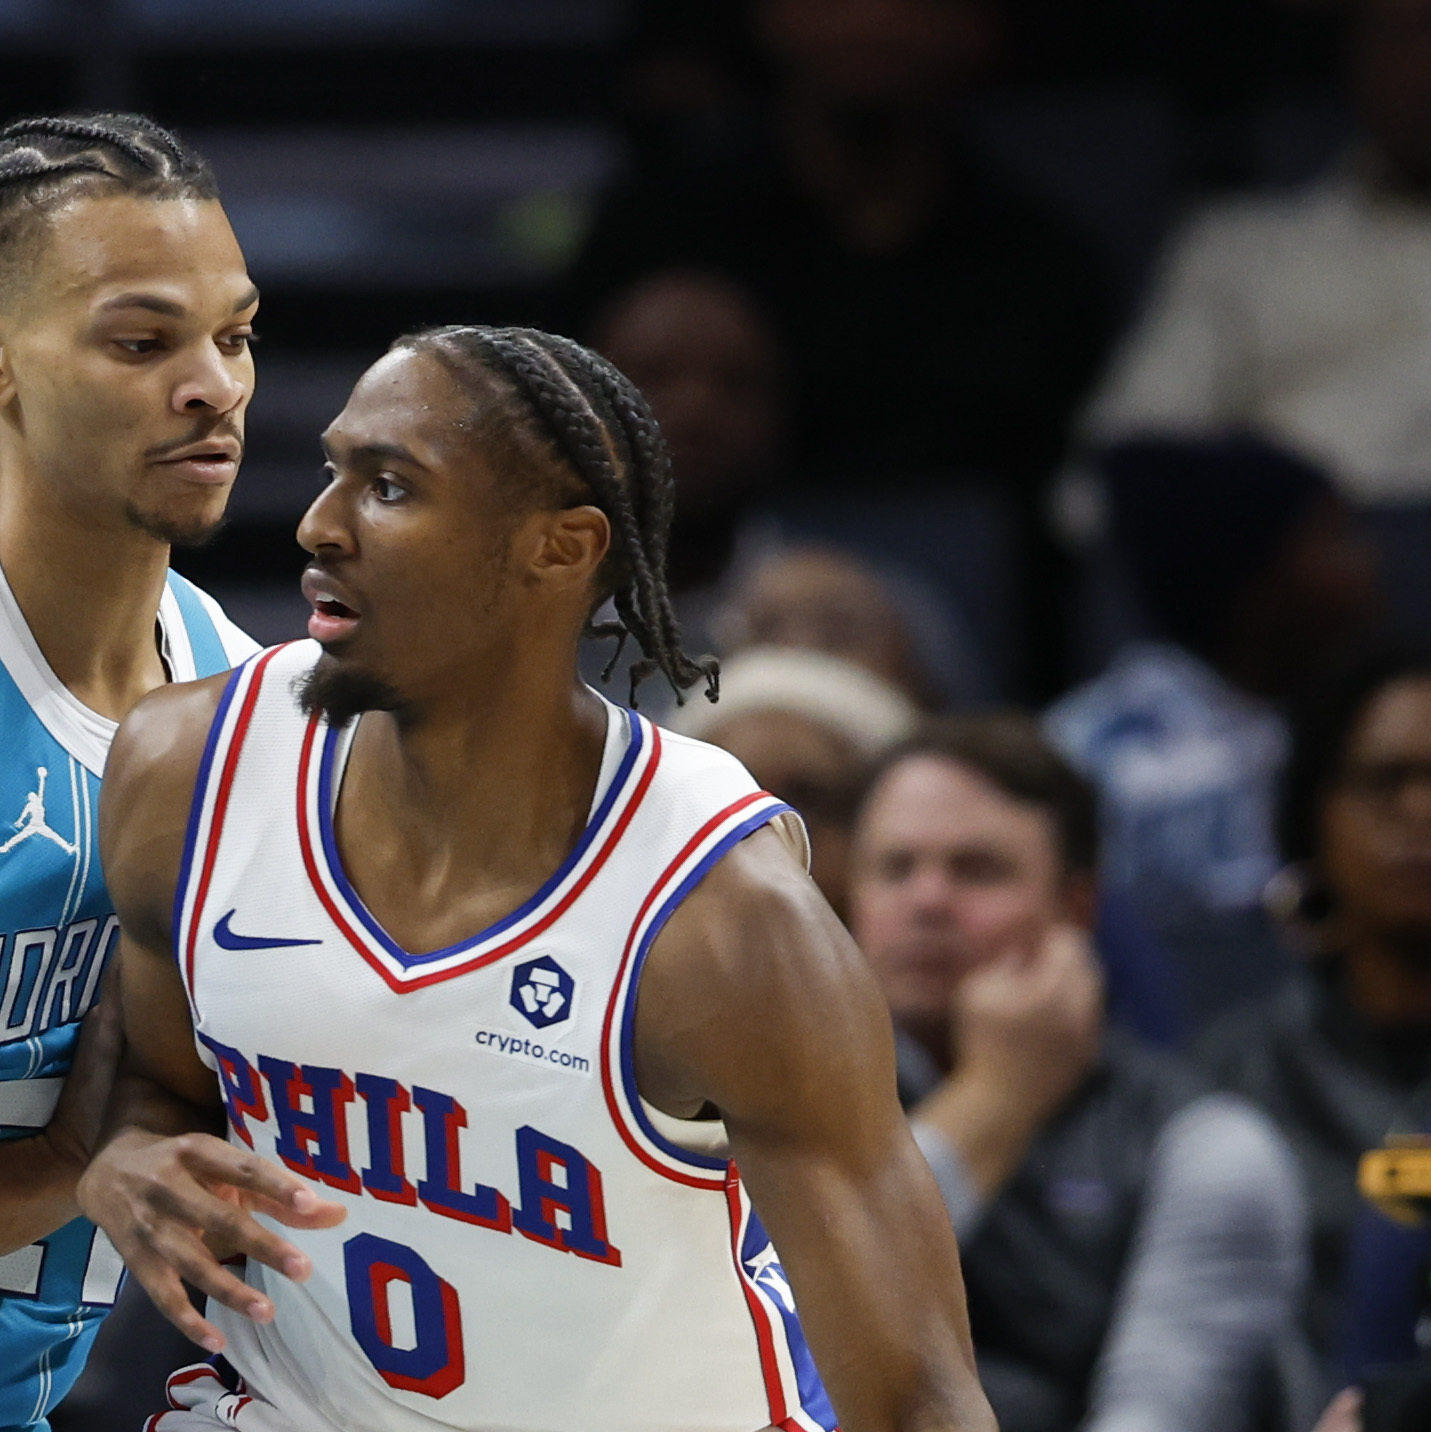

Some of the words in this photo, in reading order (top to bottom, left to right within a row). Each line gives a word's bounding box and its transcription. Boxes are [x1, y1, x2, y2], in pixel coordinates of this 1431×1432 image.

[475, 1031, 589, 1072] crypto.com
[197, 1028, 622, 1268] PHILA
[343, 1232, 466, 1400] 0
